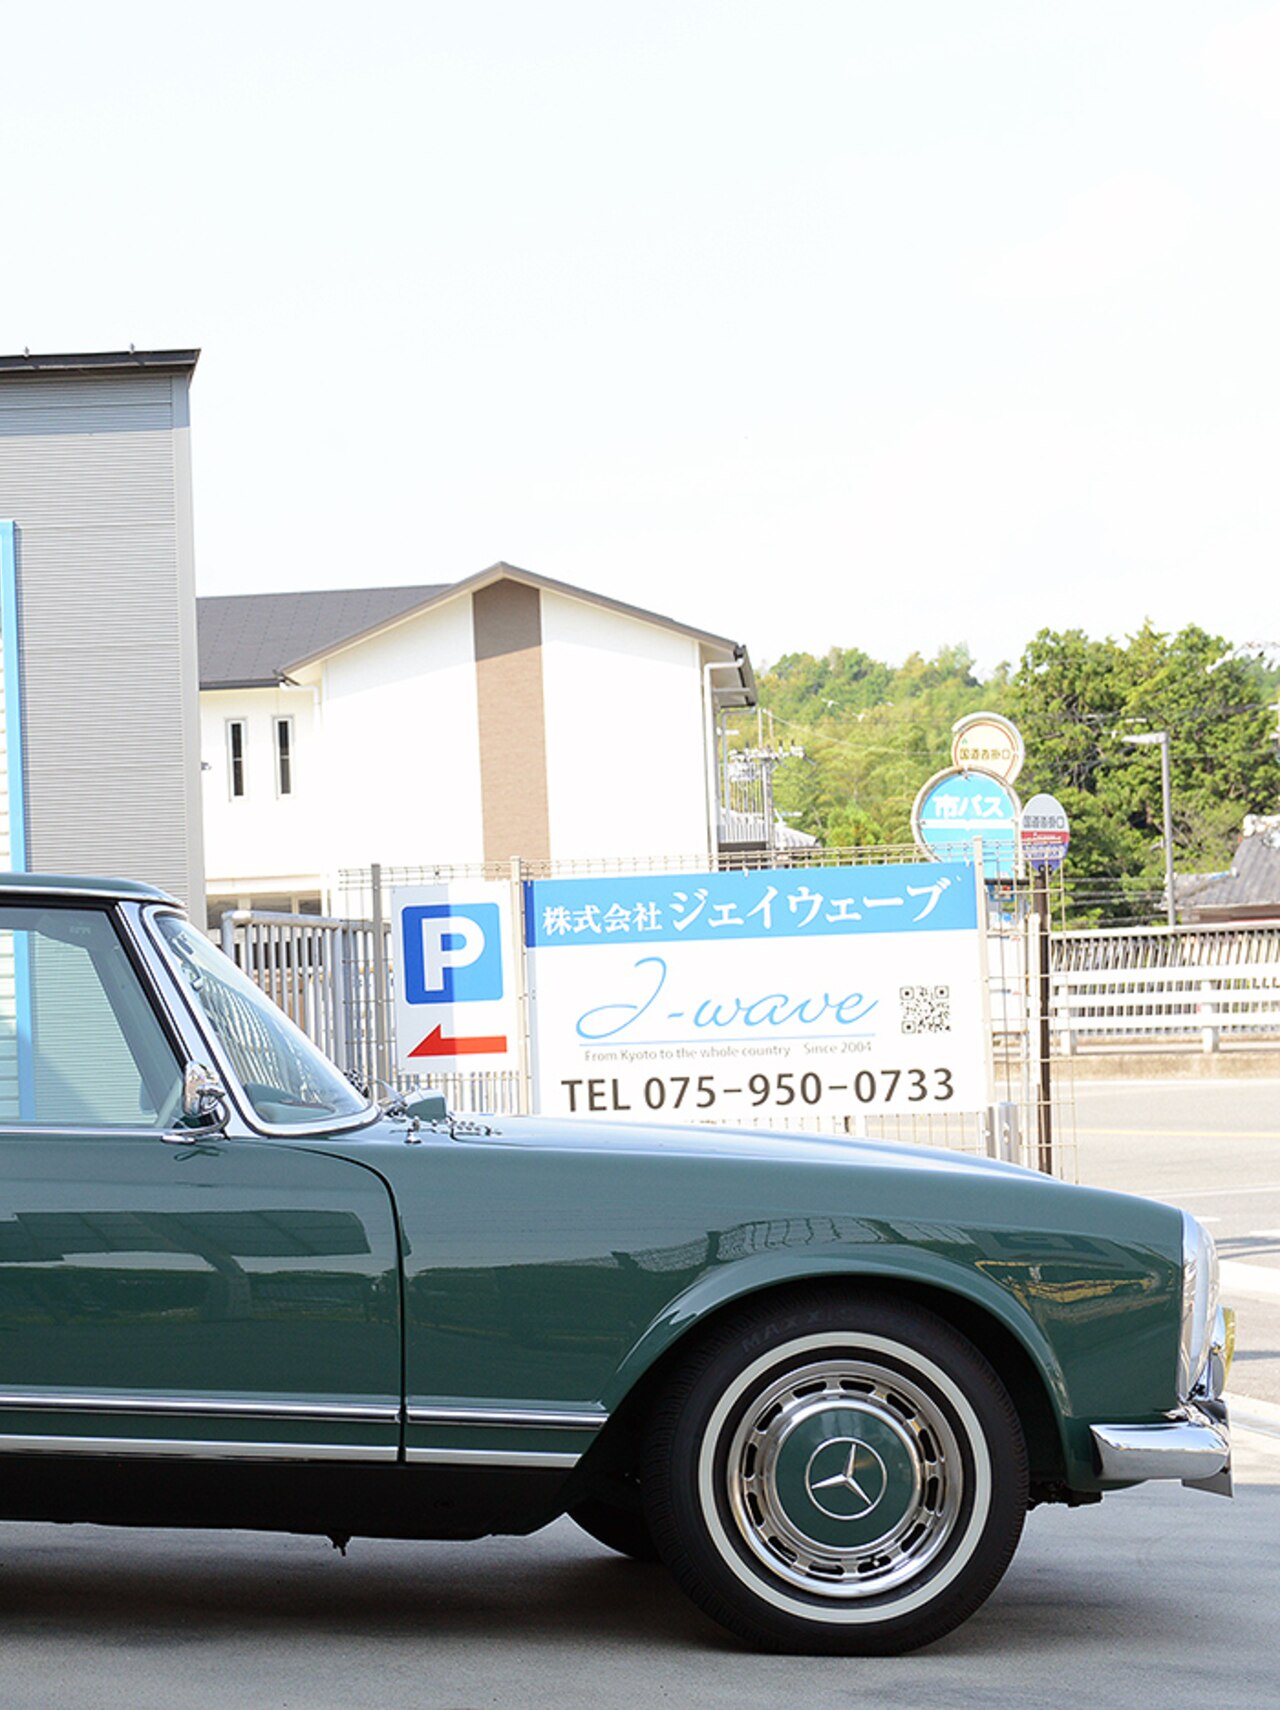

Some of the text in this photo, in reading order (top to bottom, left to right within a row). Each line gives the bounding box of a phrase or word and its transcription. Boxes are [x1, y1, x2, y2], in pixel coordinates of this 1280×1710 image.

[933, 794, 1004, 818] 市バス
[542, 876, 952, 936] 株式会社 ジェイウェーブ
[423, 917, 486, 992] P
[576, 956, 879, 1040] J-wave
[584, 1050, 618, 1062] From
[620, 1049, 658, 1063] Kyoto
[659, 1049, 674, 1060] to
[676, 1047, 698, 1059] the
[699, 1045, 740, 1058] whole
[741, 1044, 791, 1058] country
[803, 1041, 839, 1055] Since
[561, 1068, 954, 1112] TEL 075-950-0733
